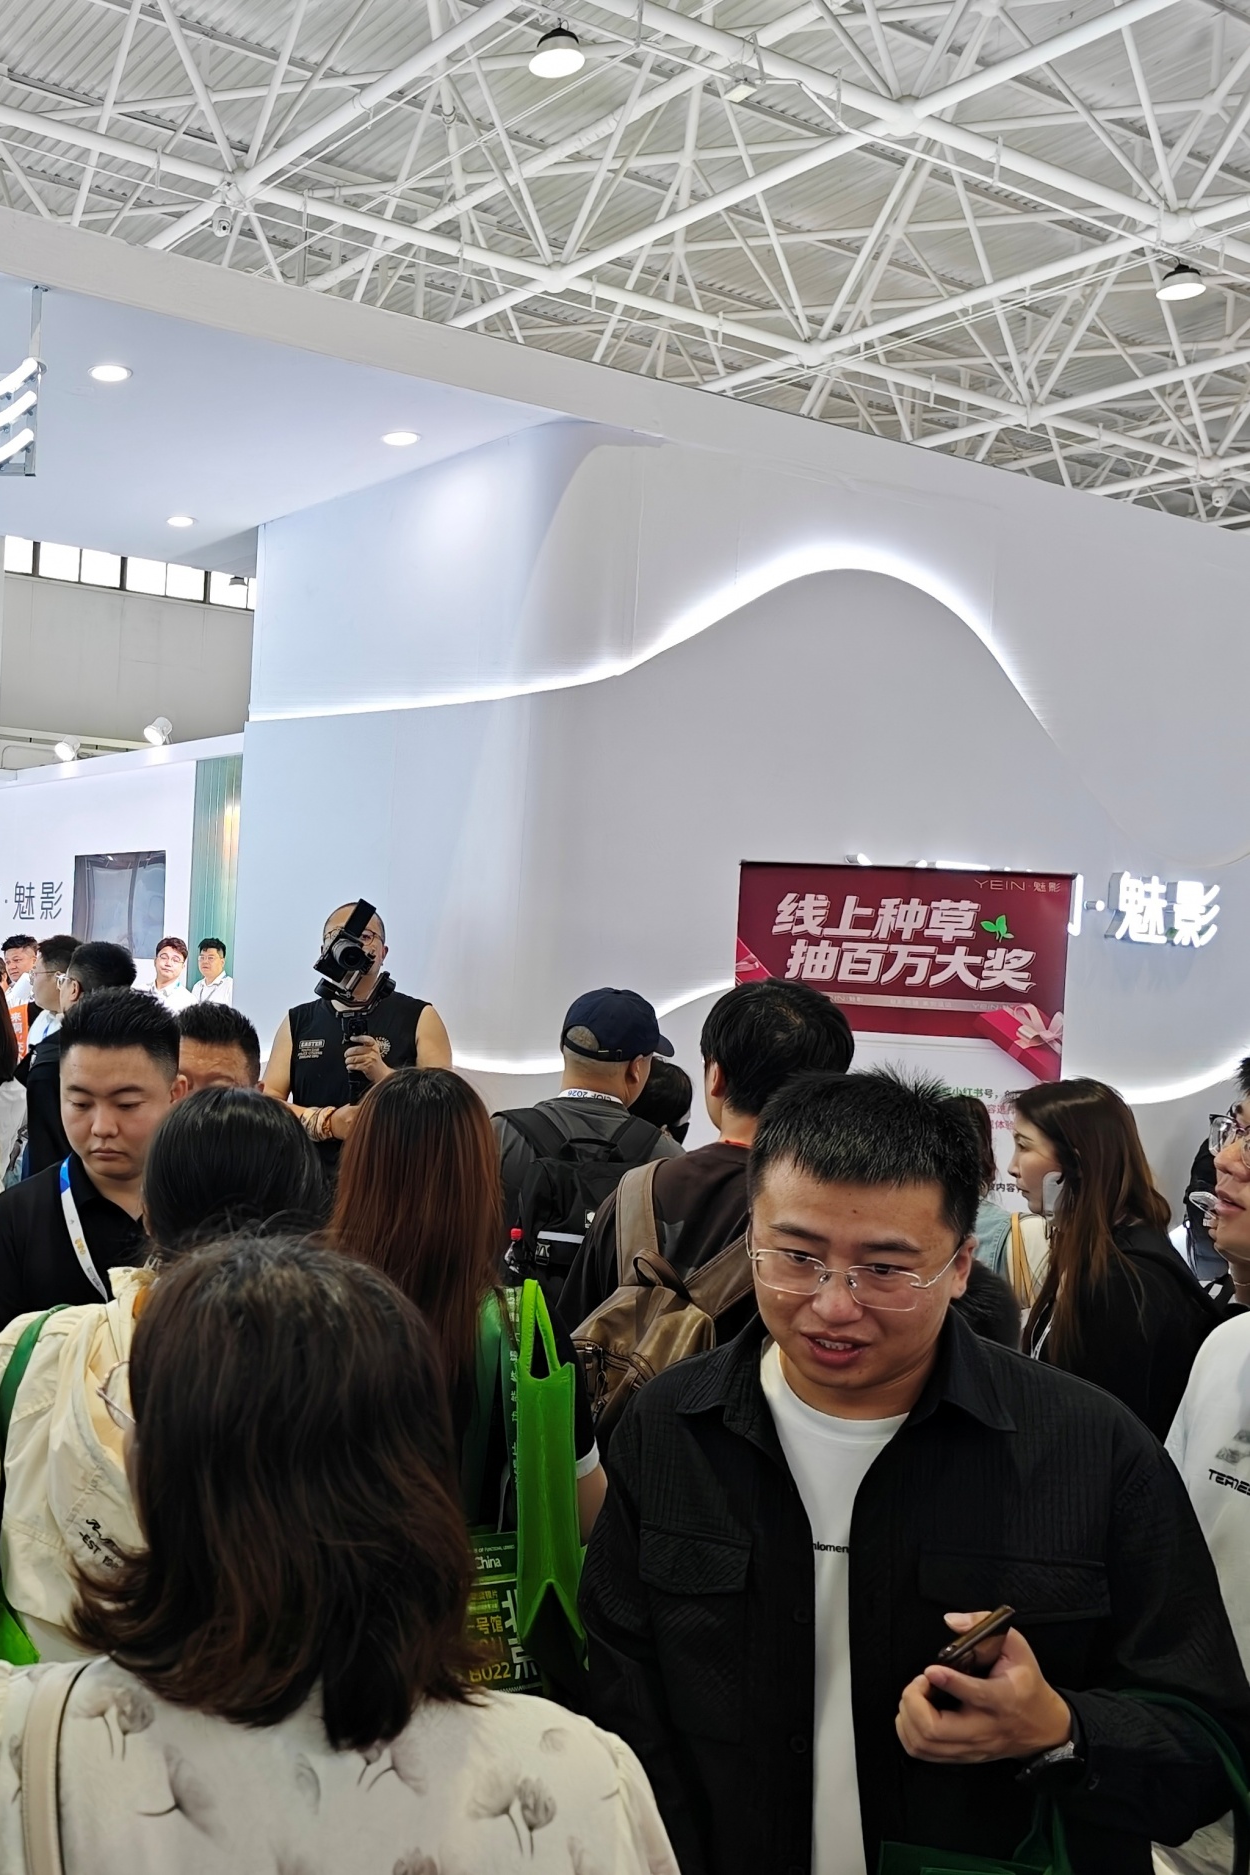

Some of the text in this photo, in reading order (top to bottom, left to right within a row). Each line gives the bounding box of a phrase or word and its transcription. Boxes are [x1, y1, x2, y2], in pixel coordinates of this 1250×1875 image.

[772, 892, 981, 943] 线上种草
[784, 938, 1037, 994] 抽百万大奖
